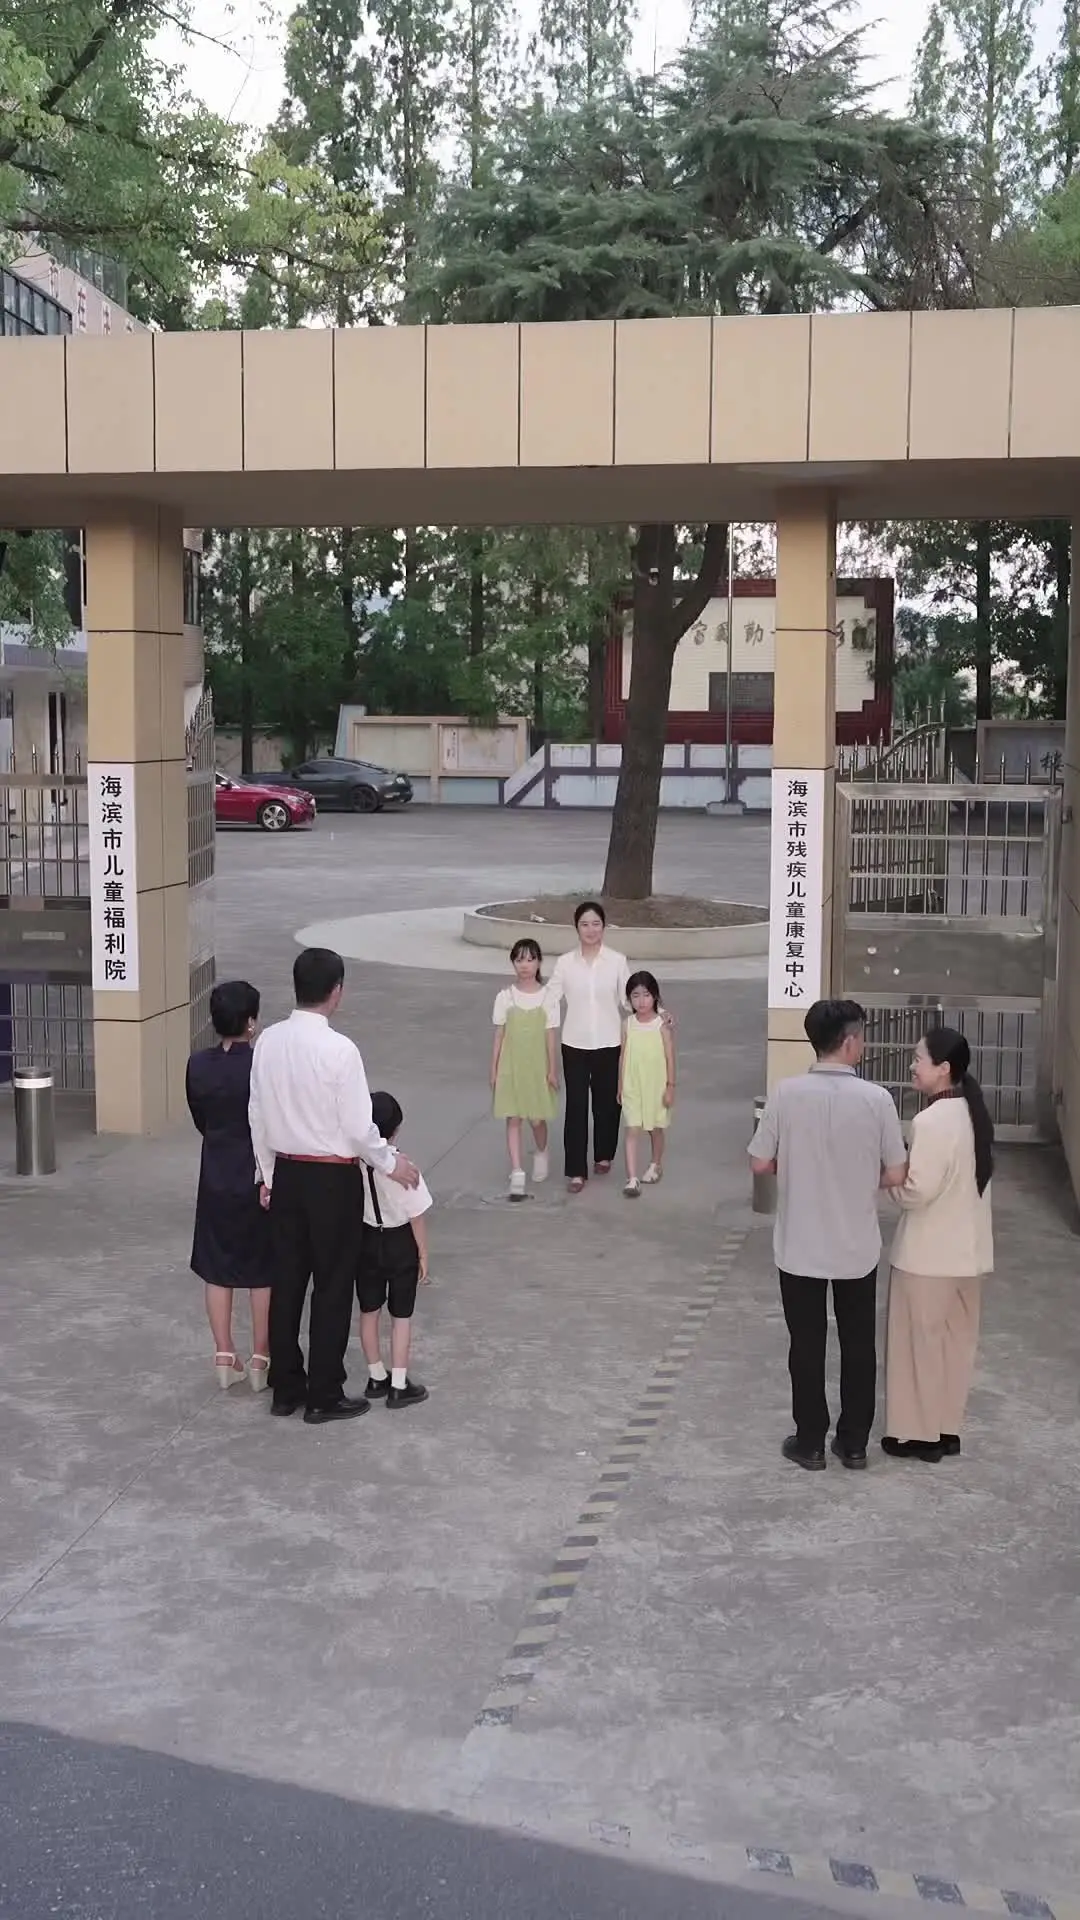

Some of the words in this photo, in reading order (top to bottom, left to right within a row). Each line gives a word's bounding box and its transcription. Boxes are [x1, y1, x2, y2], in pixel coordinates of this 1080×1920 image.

[100, 775, 127, 981] 海滨市儿童福利院
[784, 780, 809, 998] 海滨市残疾儿童康复中心
